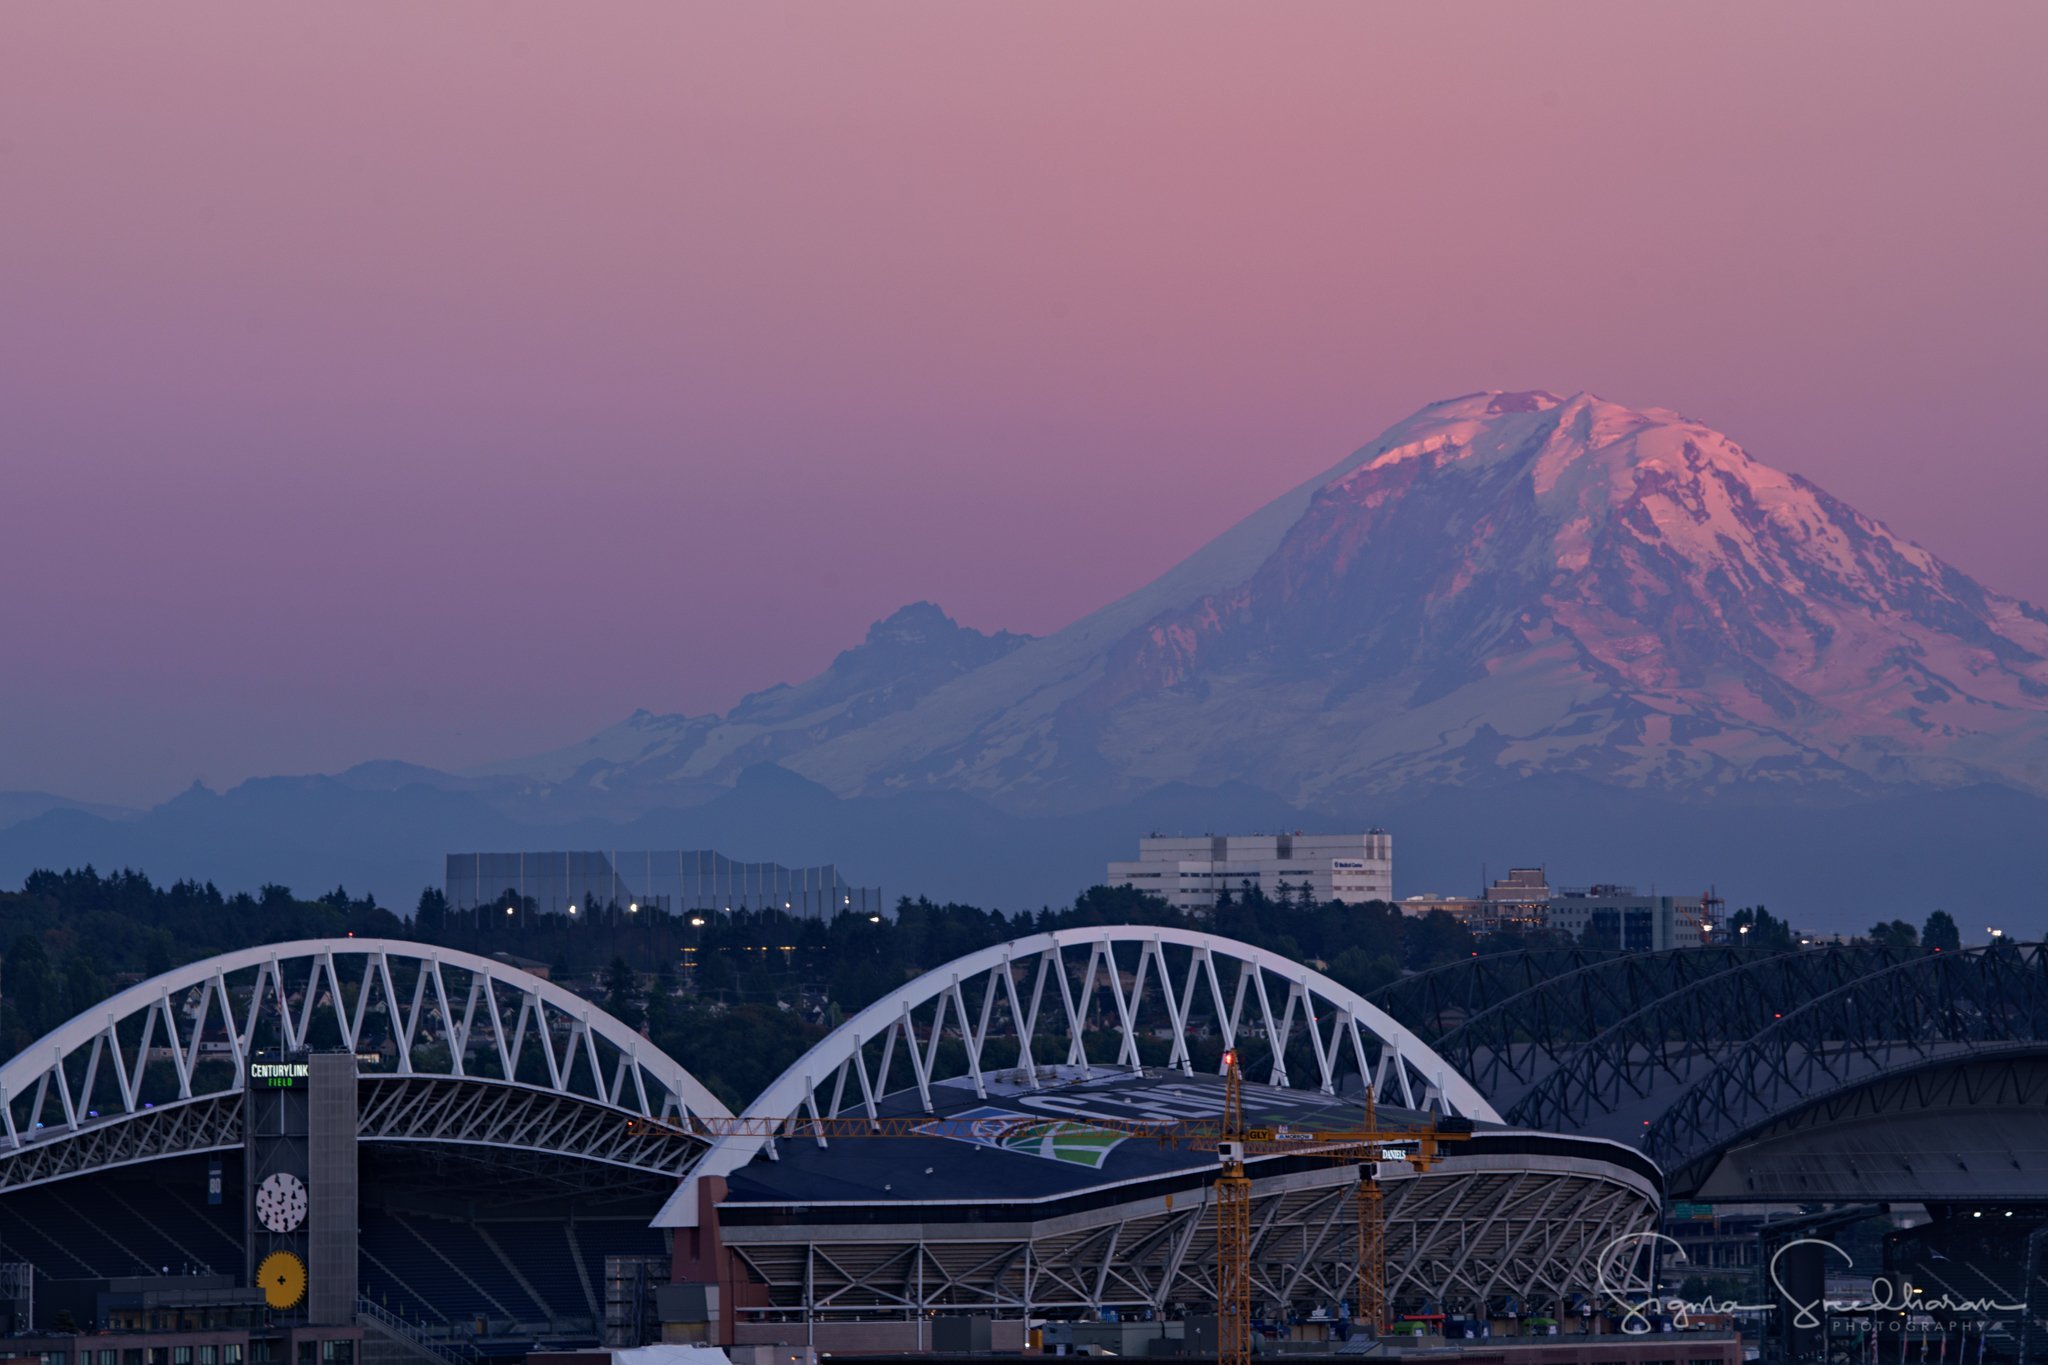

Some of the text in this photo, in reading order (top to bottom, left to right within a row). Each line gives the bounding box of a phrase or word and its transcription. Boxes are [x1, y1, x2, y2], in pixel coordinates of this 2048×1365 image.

[268, 1078, 292, 1087] FIELD
[1249, 1131, 1268, 1139] GLY
[1382, 1149, 1406, 1159] DANIELS
